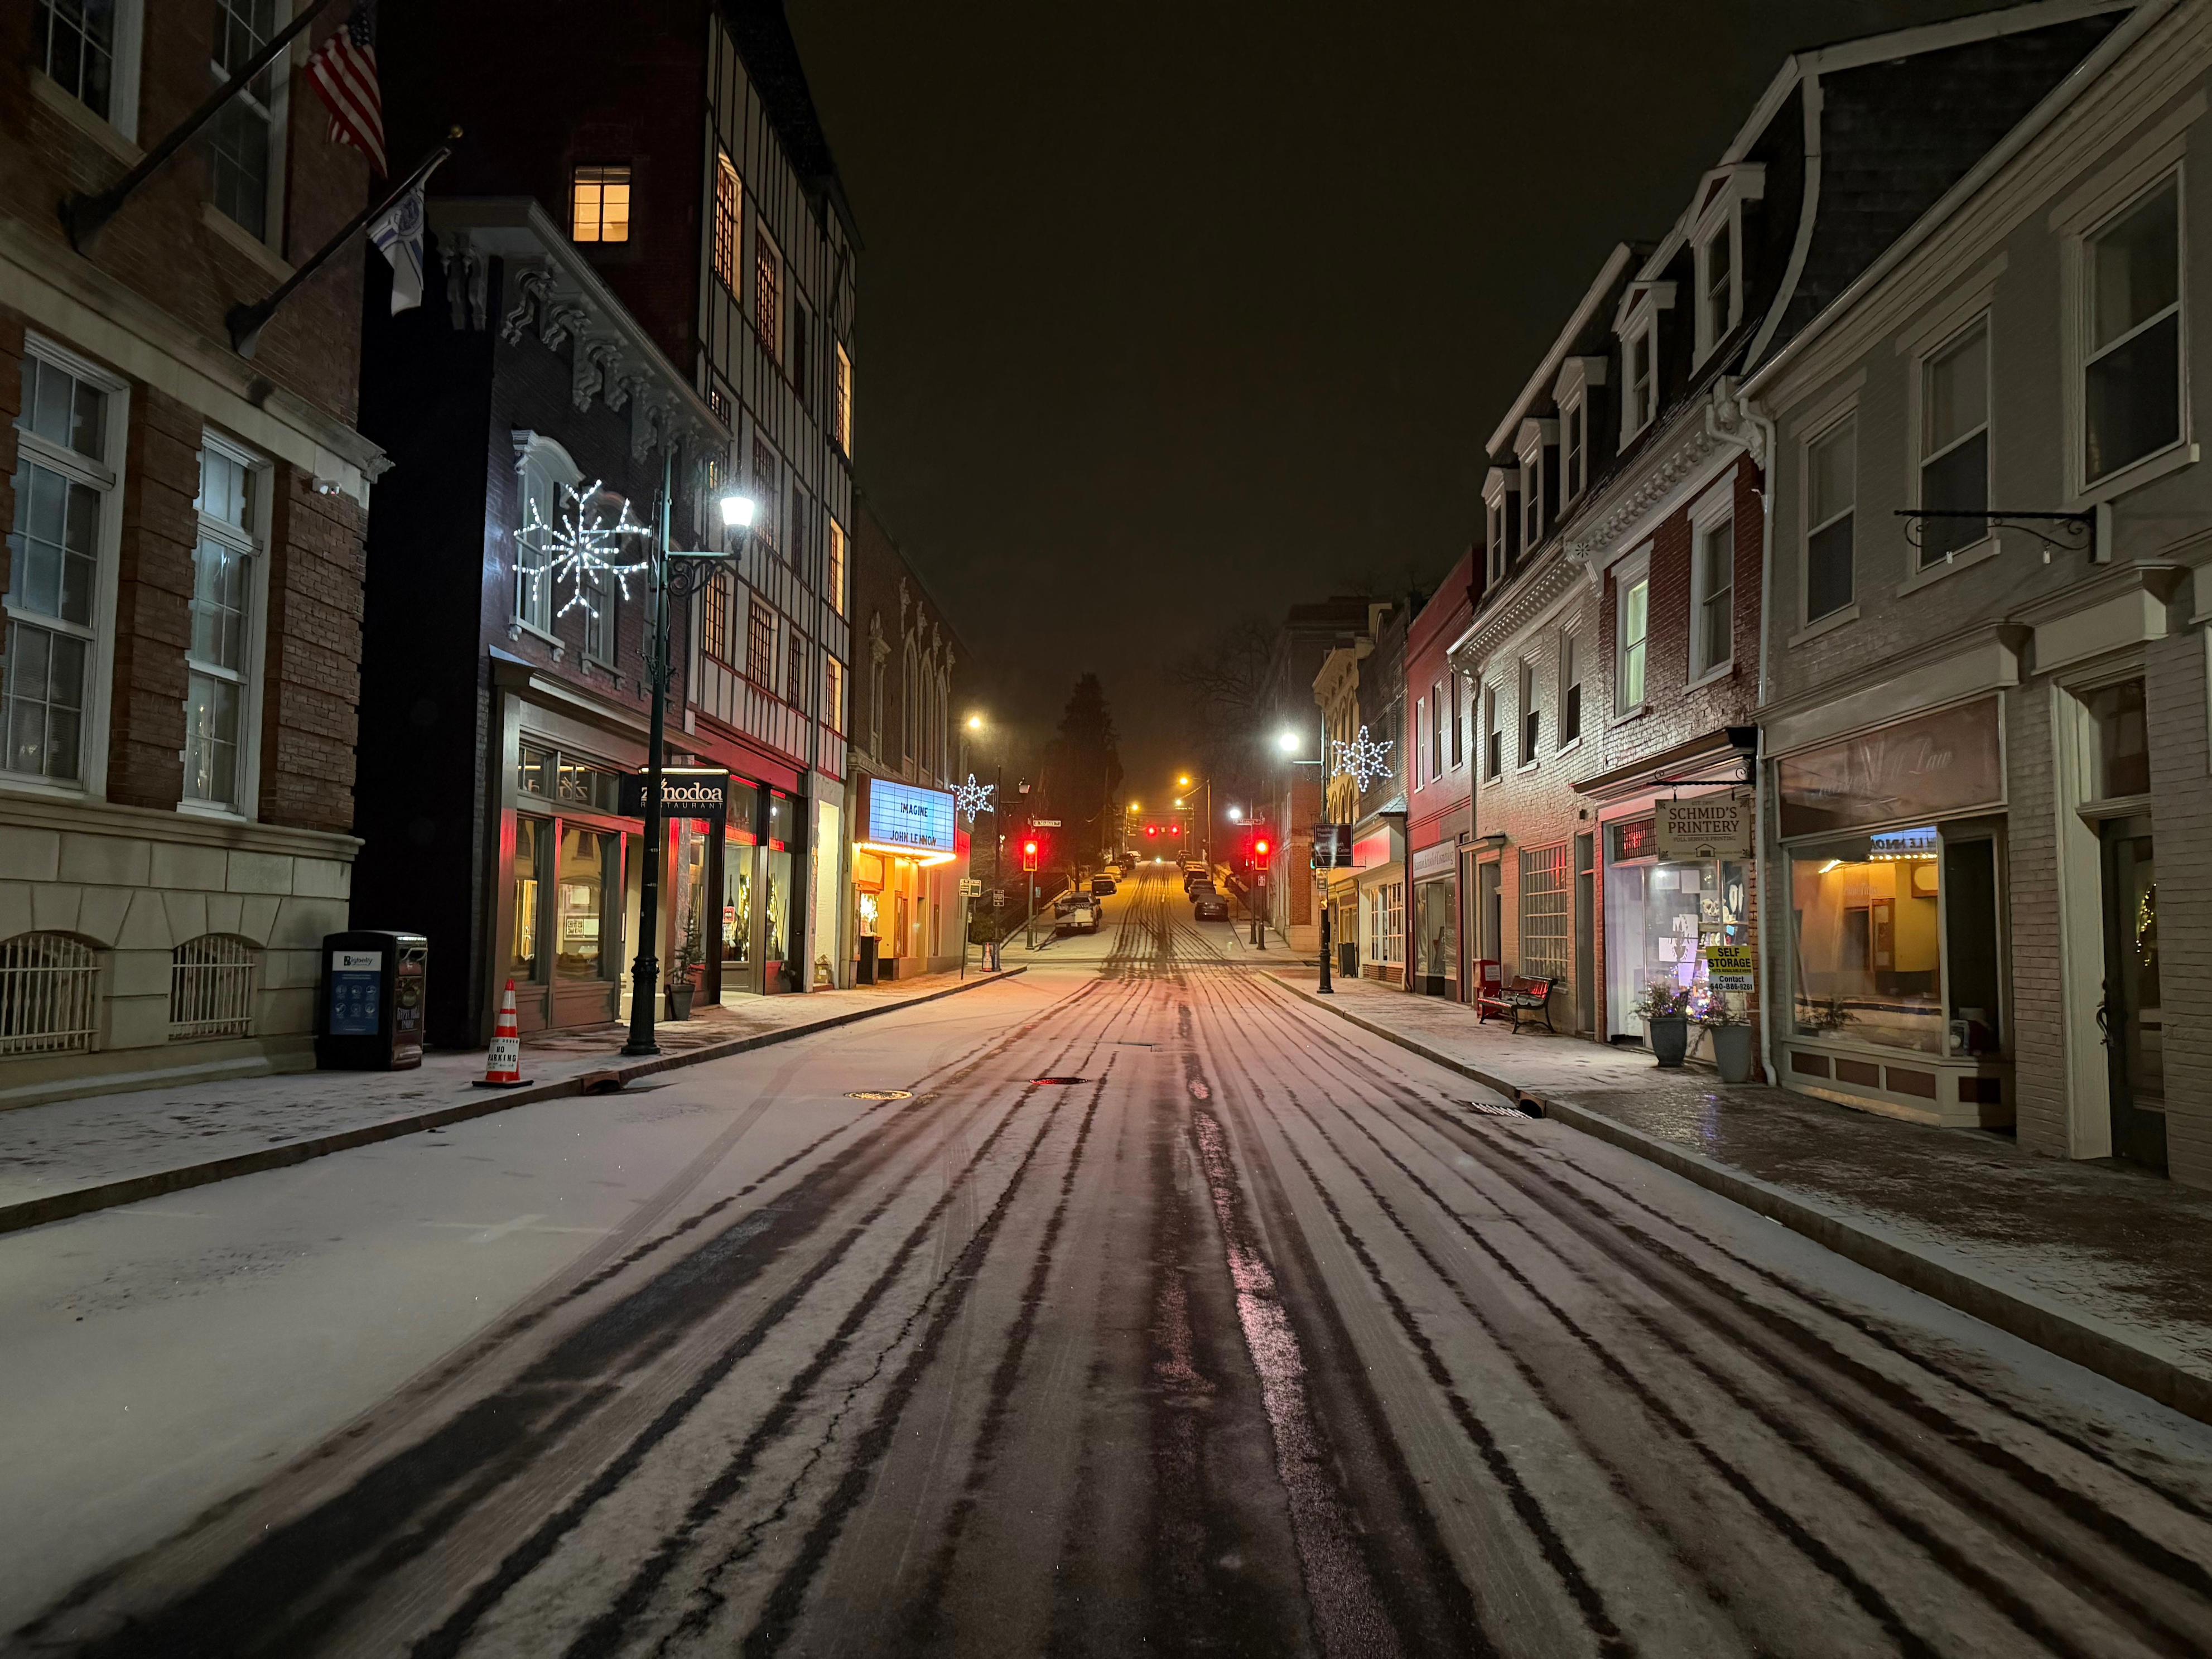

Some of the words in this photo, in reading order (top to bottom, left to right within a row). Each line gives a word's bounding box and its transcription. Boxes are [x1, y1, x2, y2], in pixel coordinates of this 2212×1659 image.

[641, 778, 722, 800] znodoa
[900, 802, 928, 817] IMAGINE
[1669, 807, 1737, 819] SCHMID'S
[1668, 820, 1739, 833] PRINTERY
[890, 830, 908, 842] JOHN
[910, 833, 937, 846] LENNON
[1718, 948, 1739, 957] SELF
[344, 956, 373, 967] Bigbelly
[1708, 958, 1751, 968] STORAGE
